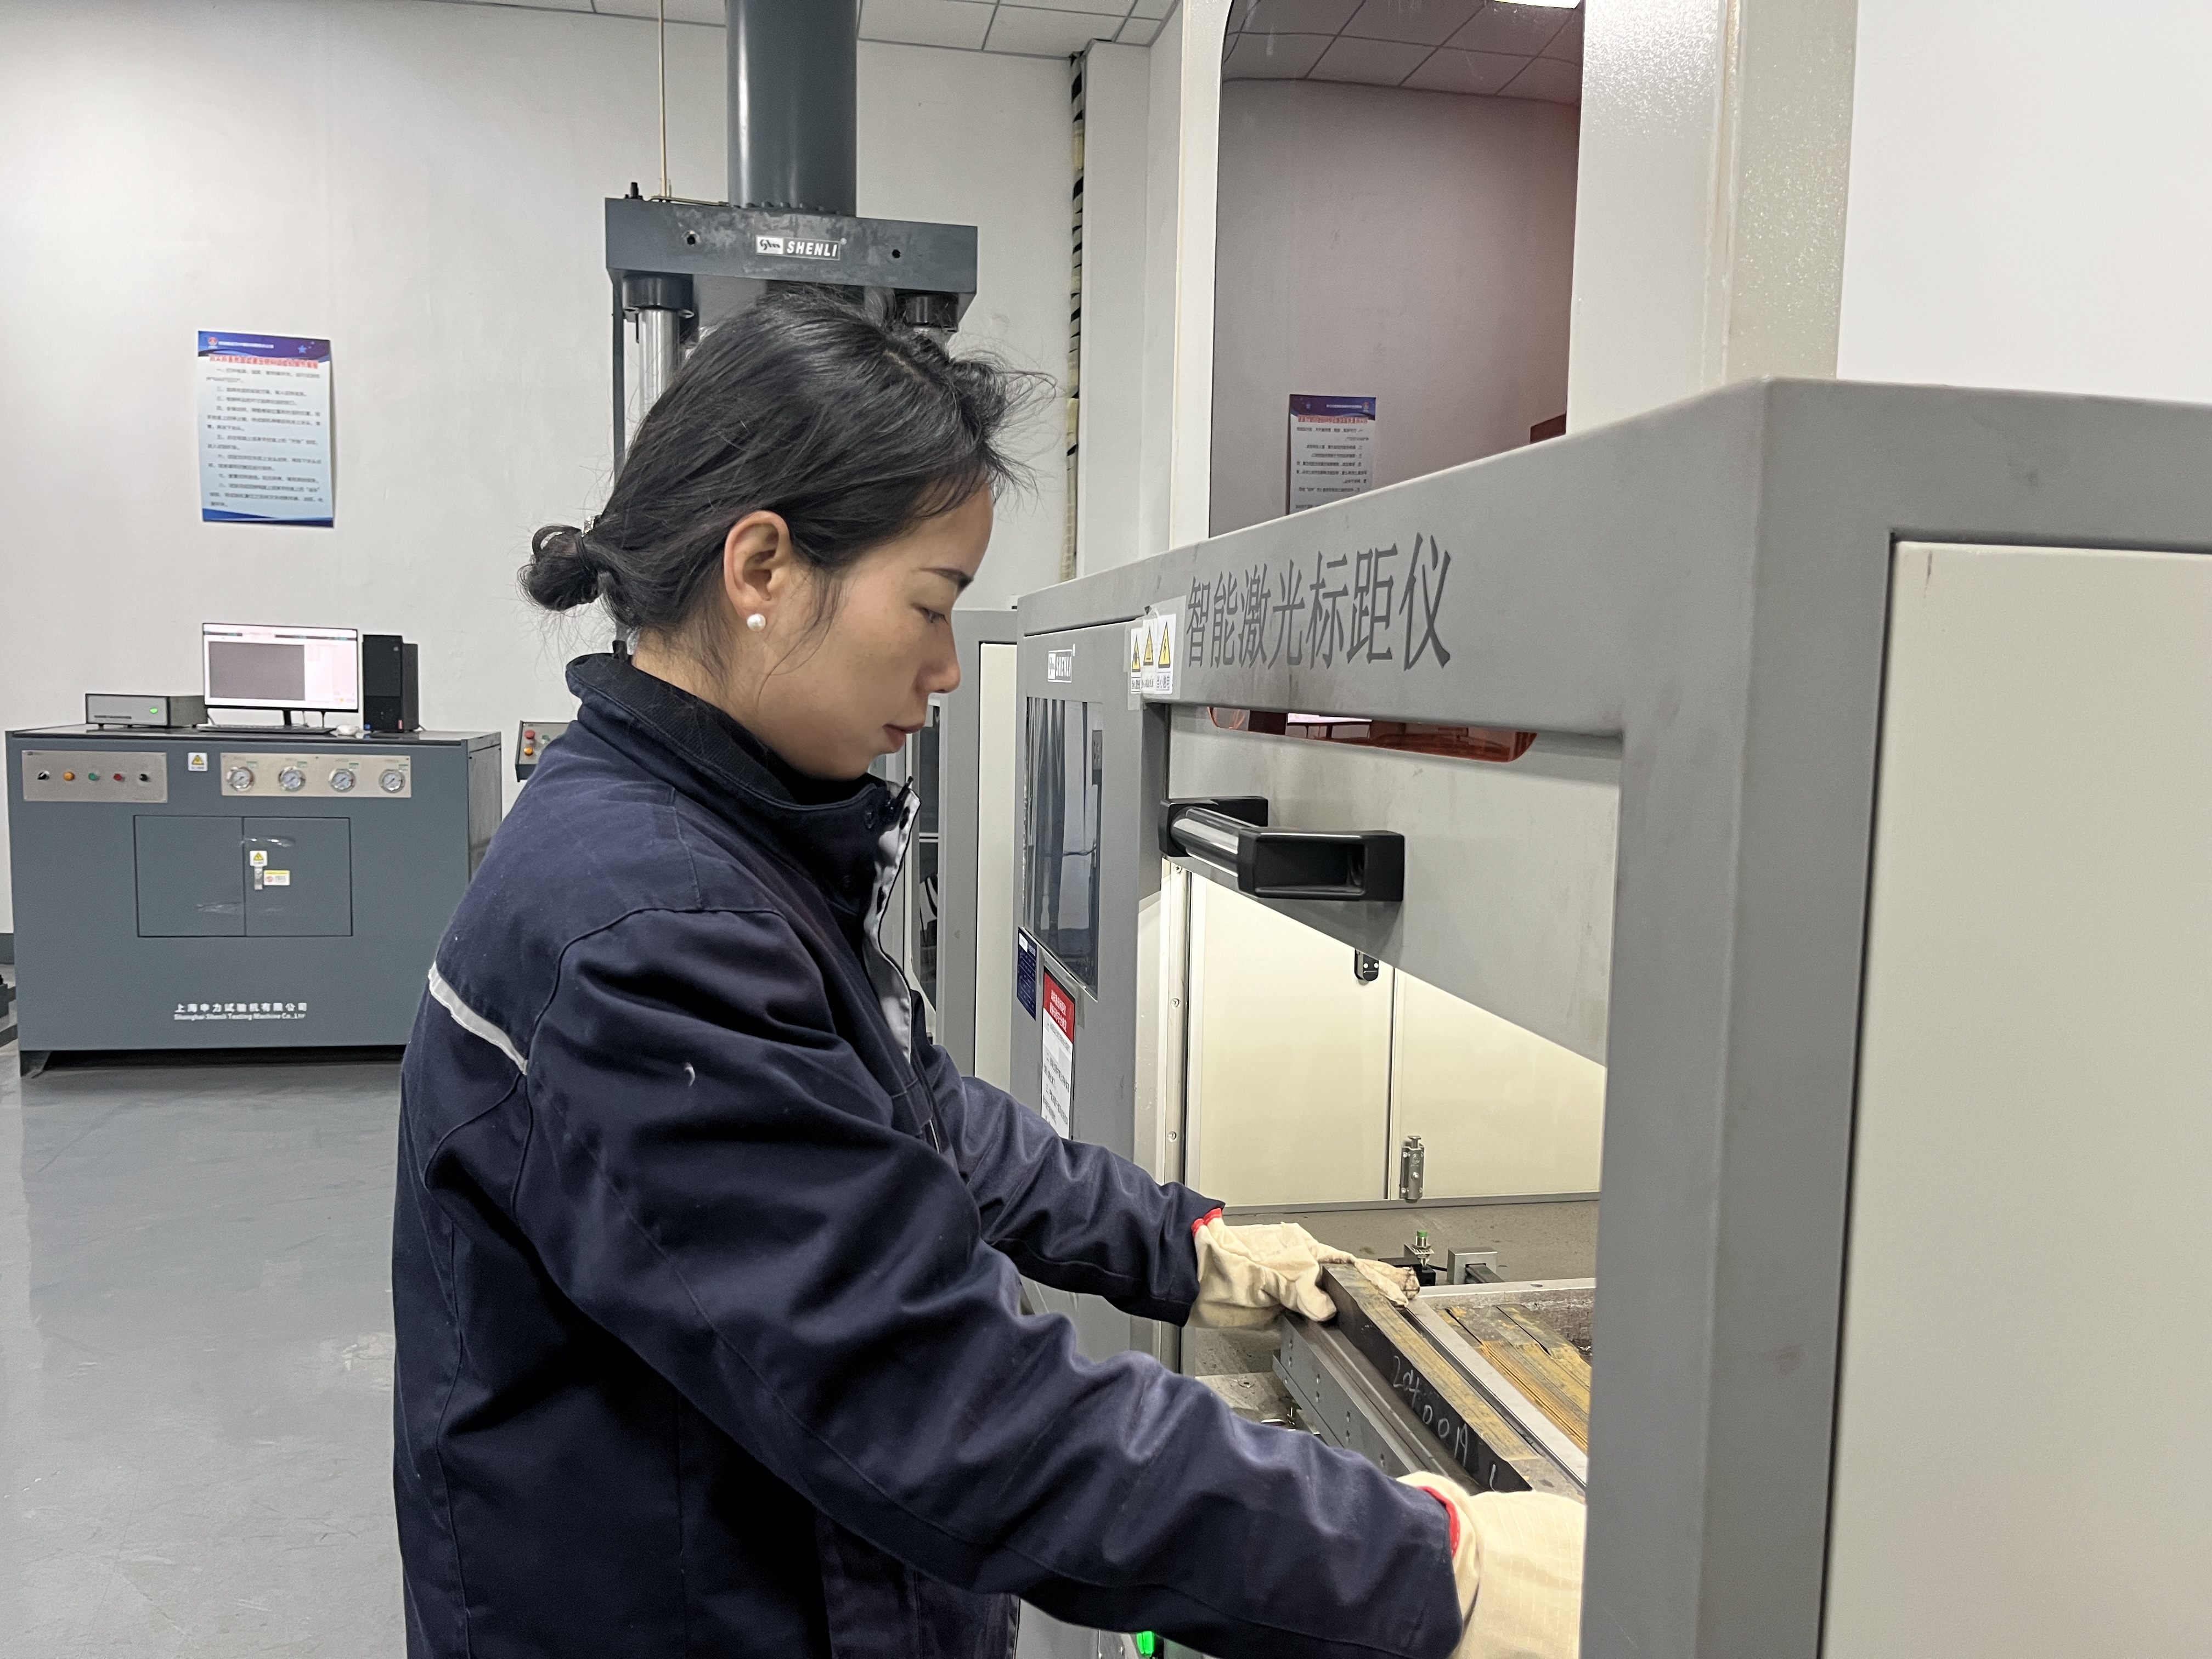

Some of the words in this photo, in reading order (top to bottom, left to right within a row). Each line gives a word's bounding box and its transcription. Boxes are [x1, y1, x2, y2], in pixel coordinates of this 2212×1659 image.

[787, 241, 837, 257] SHENLI
[1186, 532, 1451, 671] 智能激光标距仪
